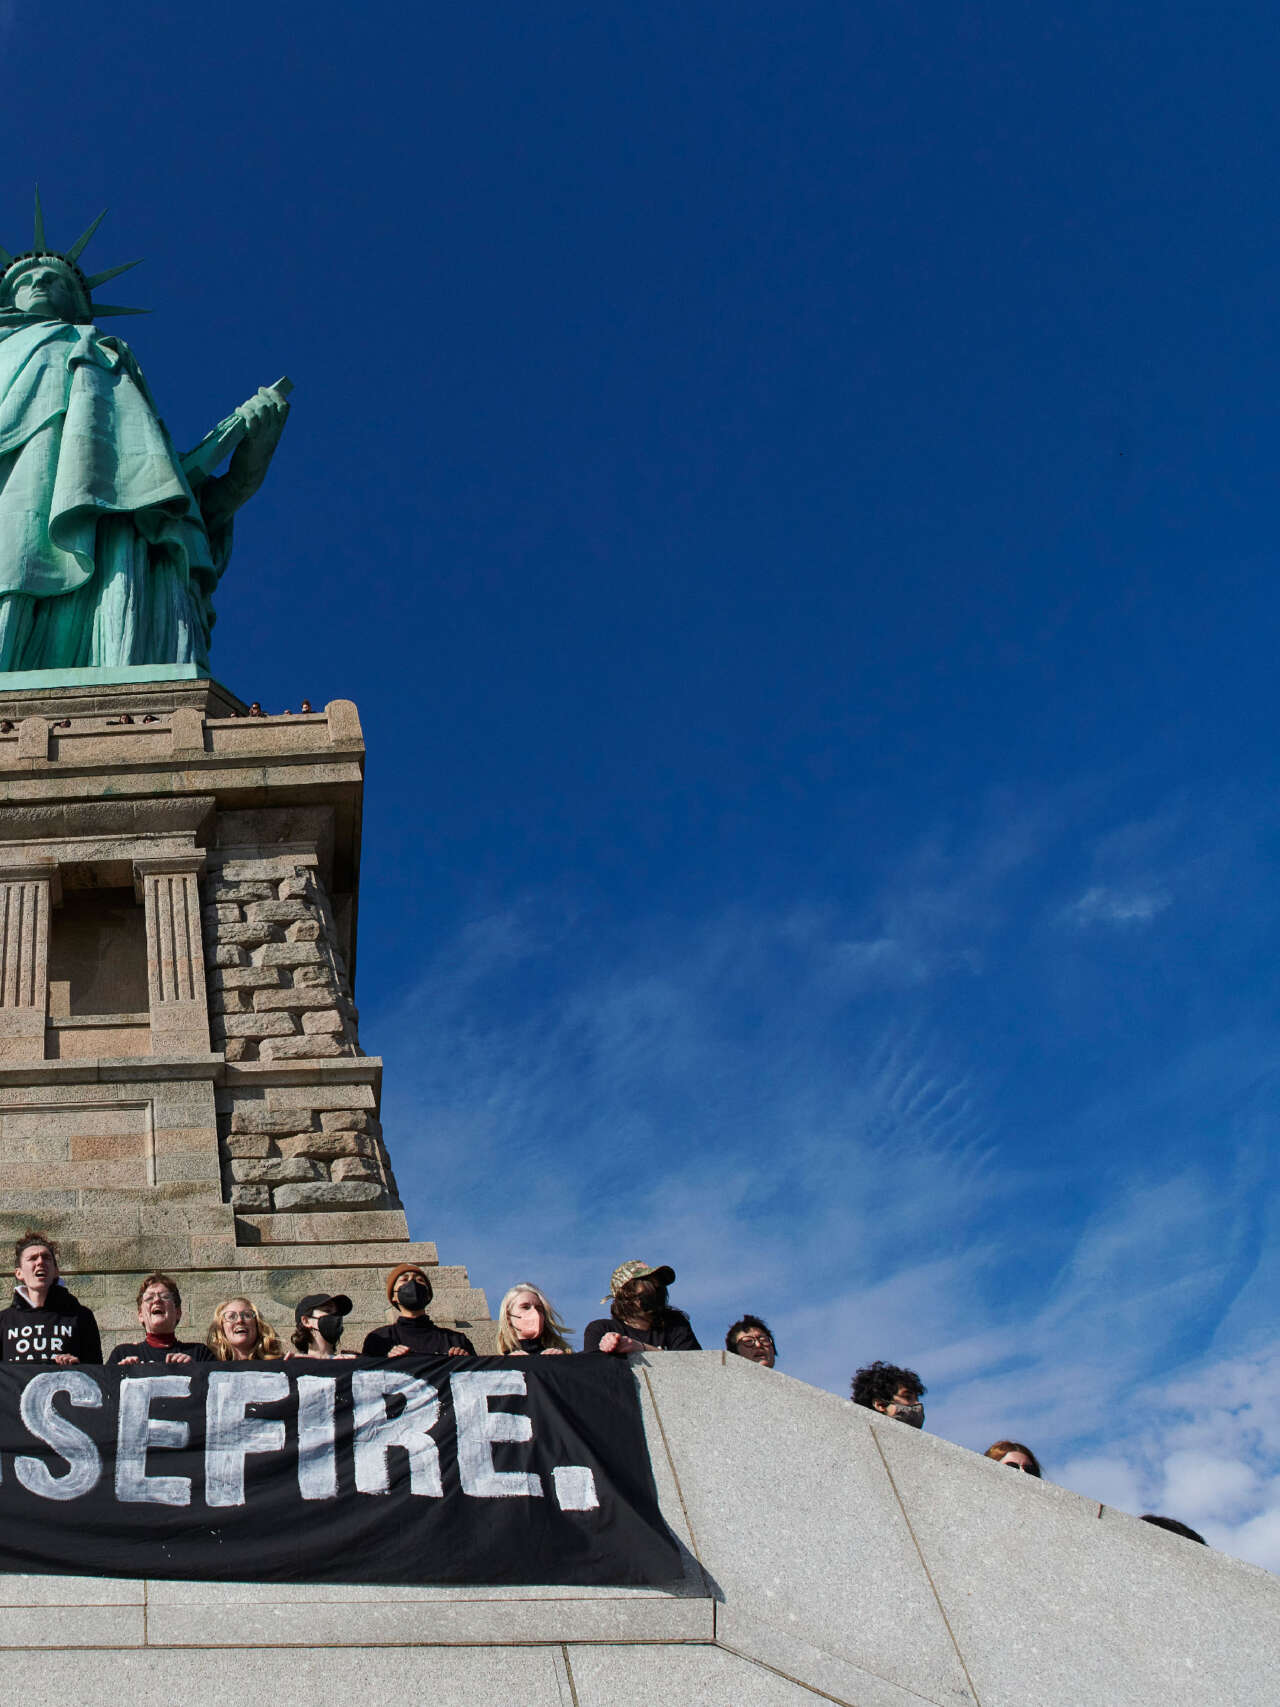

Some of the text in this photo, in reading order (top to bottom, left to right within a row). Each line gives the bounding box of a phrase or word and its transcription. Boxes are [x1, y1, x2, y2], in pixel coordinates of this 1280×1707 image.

[8, 1325, 72, 1339] NOT IN
[15, 1338, 64, 1353] OUR
